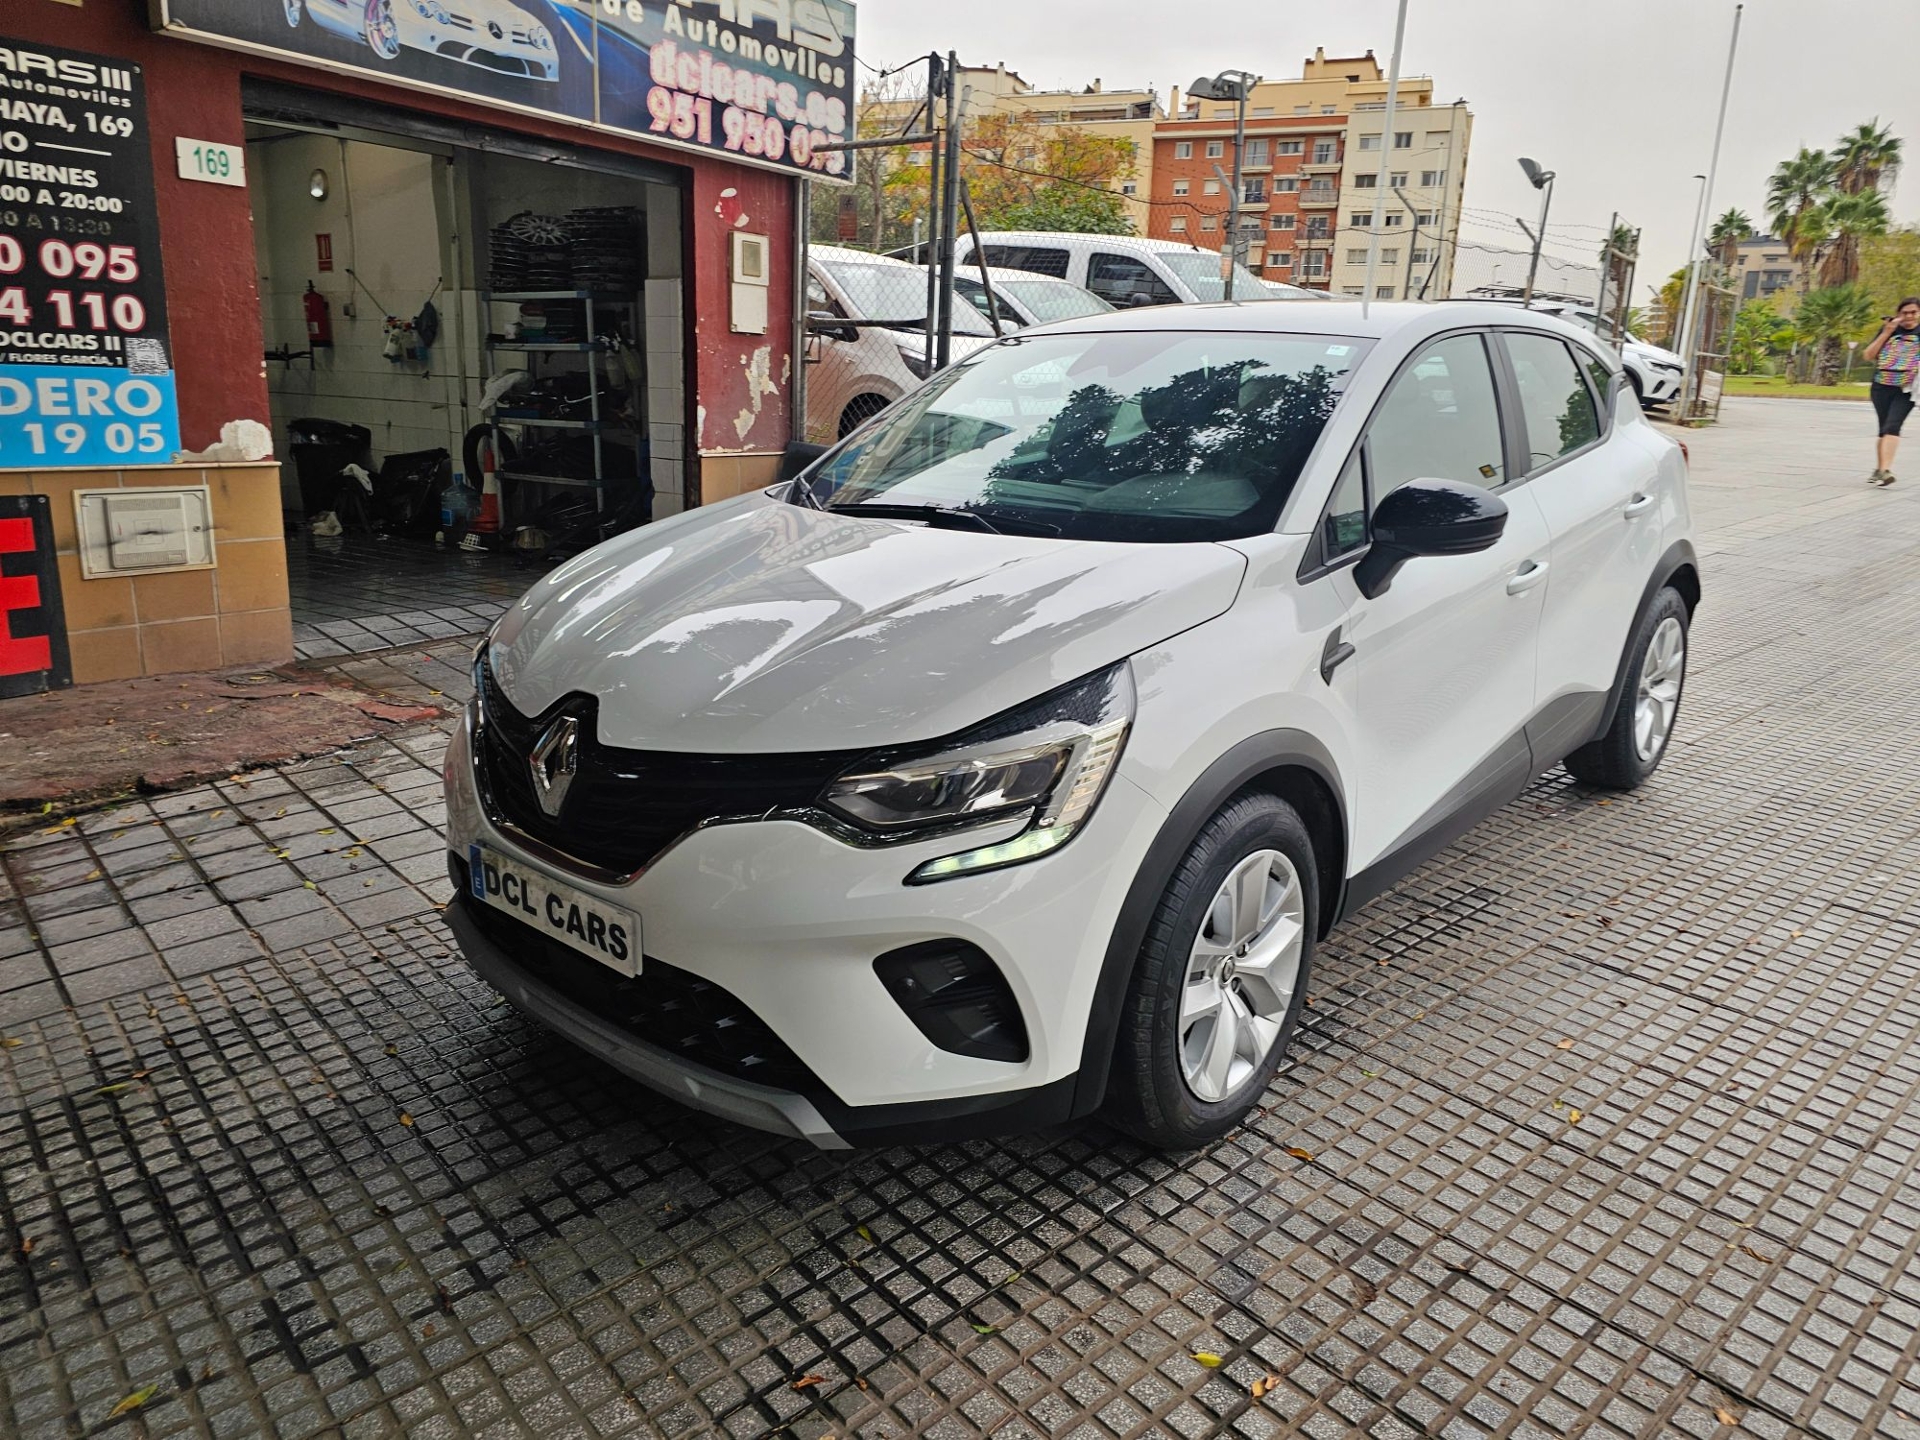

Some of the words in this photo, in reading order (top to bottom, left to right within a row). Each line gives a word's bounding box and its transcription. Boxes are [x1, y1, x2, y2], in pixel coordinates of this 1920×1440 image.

[663, 3, 846, 89] Automoviles
[649, 38, 847, 134] dclcars.es
[84, 111, 134, 138] 169
[646, 86, 712, 144] 951
[722, 106, 785, 161] 950
[789, 124, 847, 175] 095
[193, 146, 230, 177] 169
[36, 189, 55, 206] A
[58, 191, 123, 213] 20:00
[38, 238, 140, 284] 095
[0, 286, 33, 327] 4
[46, 288, 147, 333] 110
[8, 352, 59, 364] FLORES
[115, 356, 123, 366] 1
[103, 335, 122, 351] II
[0, 377, 163, 417] DERO
[22, 422, 87, 455] 19
[104, 422, 165, 454] 05
[0, 517, 54, 677] E
[483, 862, 538, 917] DCL
[545, 892, 629, 961] CARS
